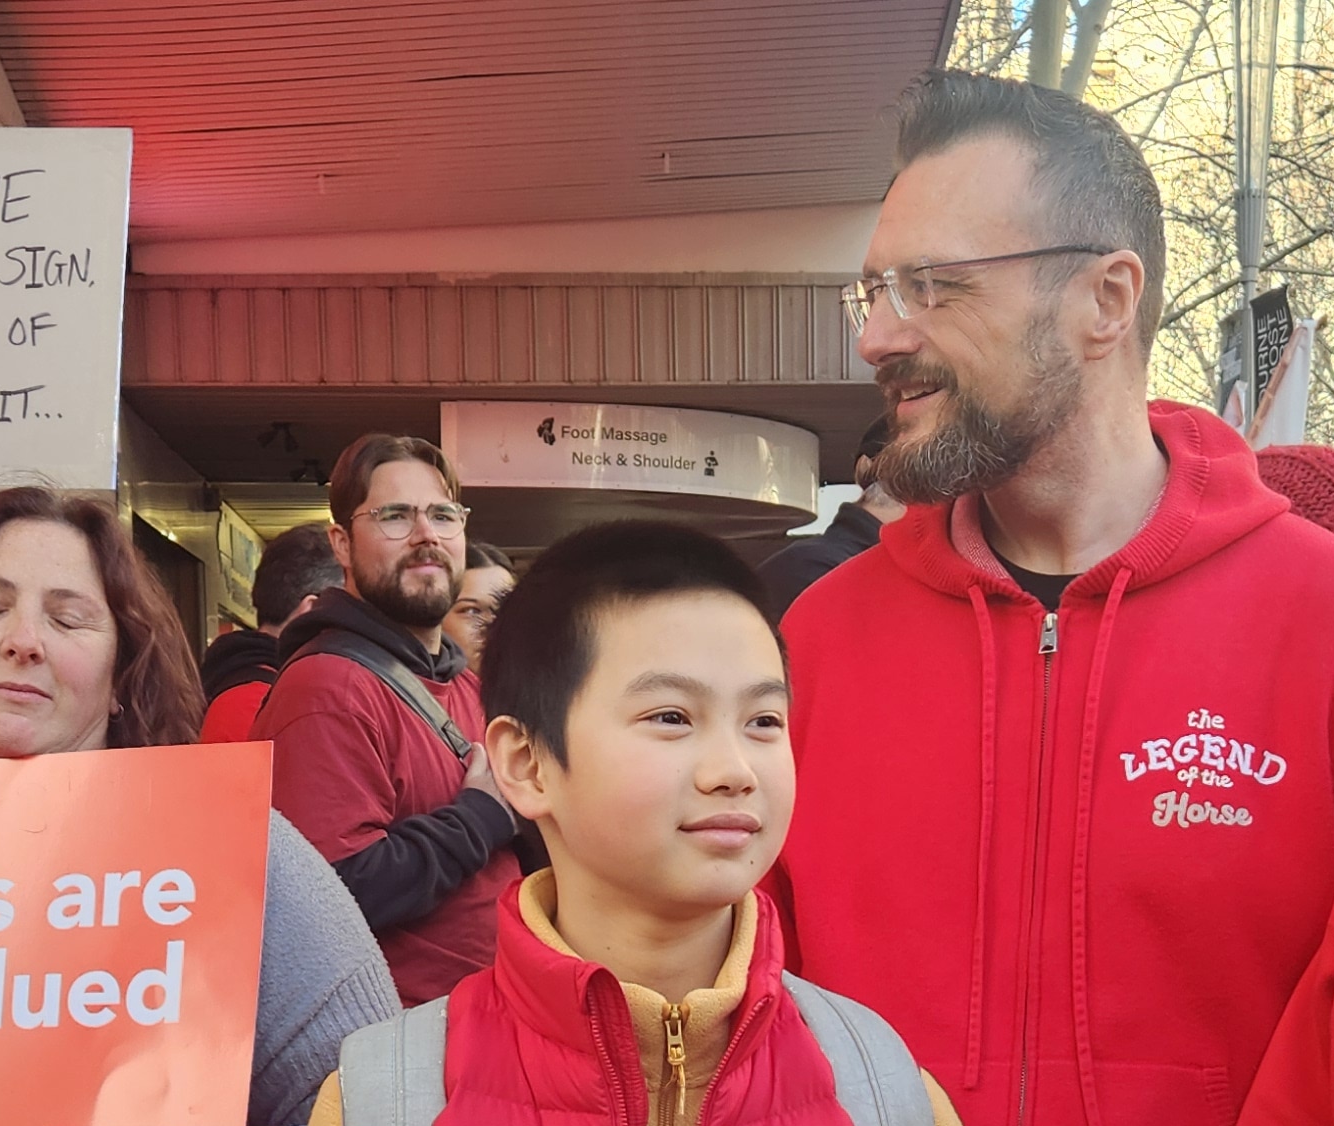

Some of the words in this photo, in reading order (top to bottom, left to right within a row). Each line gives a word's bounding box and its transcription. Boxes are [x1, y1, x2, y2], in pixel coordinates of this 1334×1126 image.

[8, 313, 58, 347] OF
[561, 426, 596, 440] Foot
[601, 427, 667, 444] Massage
[572, 452, 612, 466] Neck
[616, 454, 628, 467] &
[633, 454, 697, 471] Shoulder
[1187, 708, 1225, 729] the
[1120, 733, 1287, 785] LEGEND
[1177, 766, 1199, 788] of
[1201, 769, 1234, 788] the
[1152, 790, 1253, 828] Horse
[46, 867, 197, 932] are
